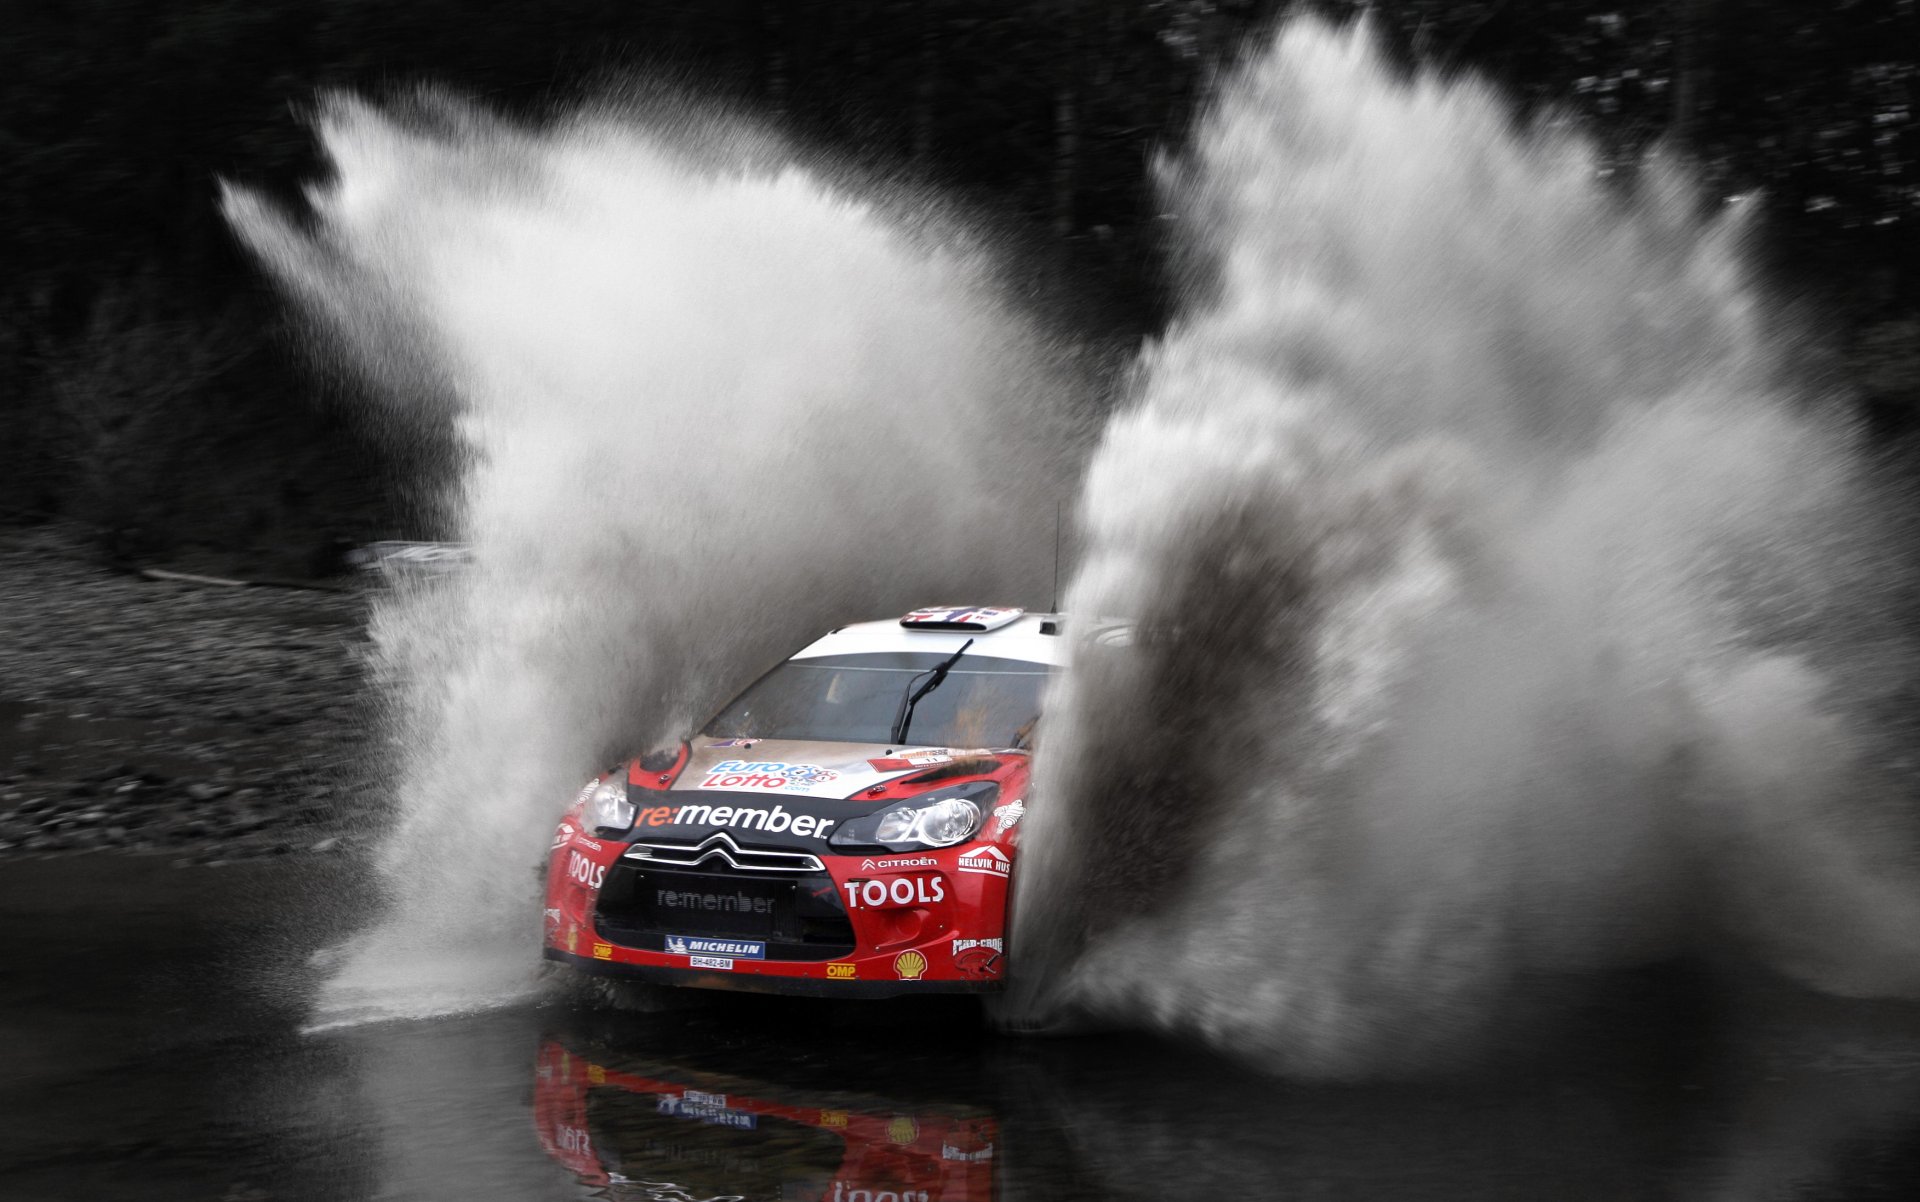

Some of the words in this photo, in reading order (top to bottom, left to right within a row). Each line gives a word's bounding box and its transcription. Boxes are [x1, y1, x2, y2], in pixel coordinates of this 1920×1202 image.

[703, 773, 786, 788] Lotto
[636, 804, 835, 840] re:member
[568, 850, 606, 889] TOOLS
[958, 857, 992, 869] HELLVIK
[995, 862, 1011, 873] HUS
[657, 889, 776, 914] re:member
[844, 876, 944, 908] TOOLS
[689, 941, 760, 954] MICHELIN
[826, 965, 856, 978] OMP
